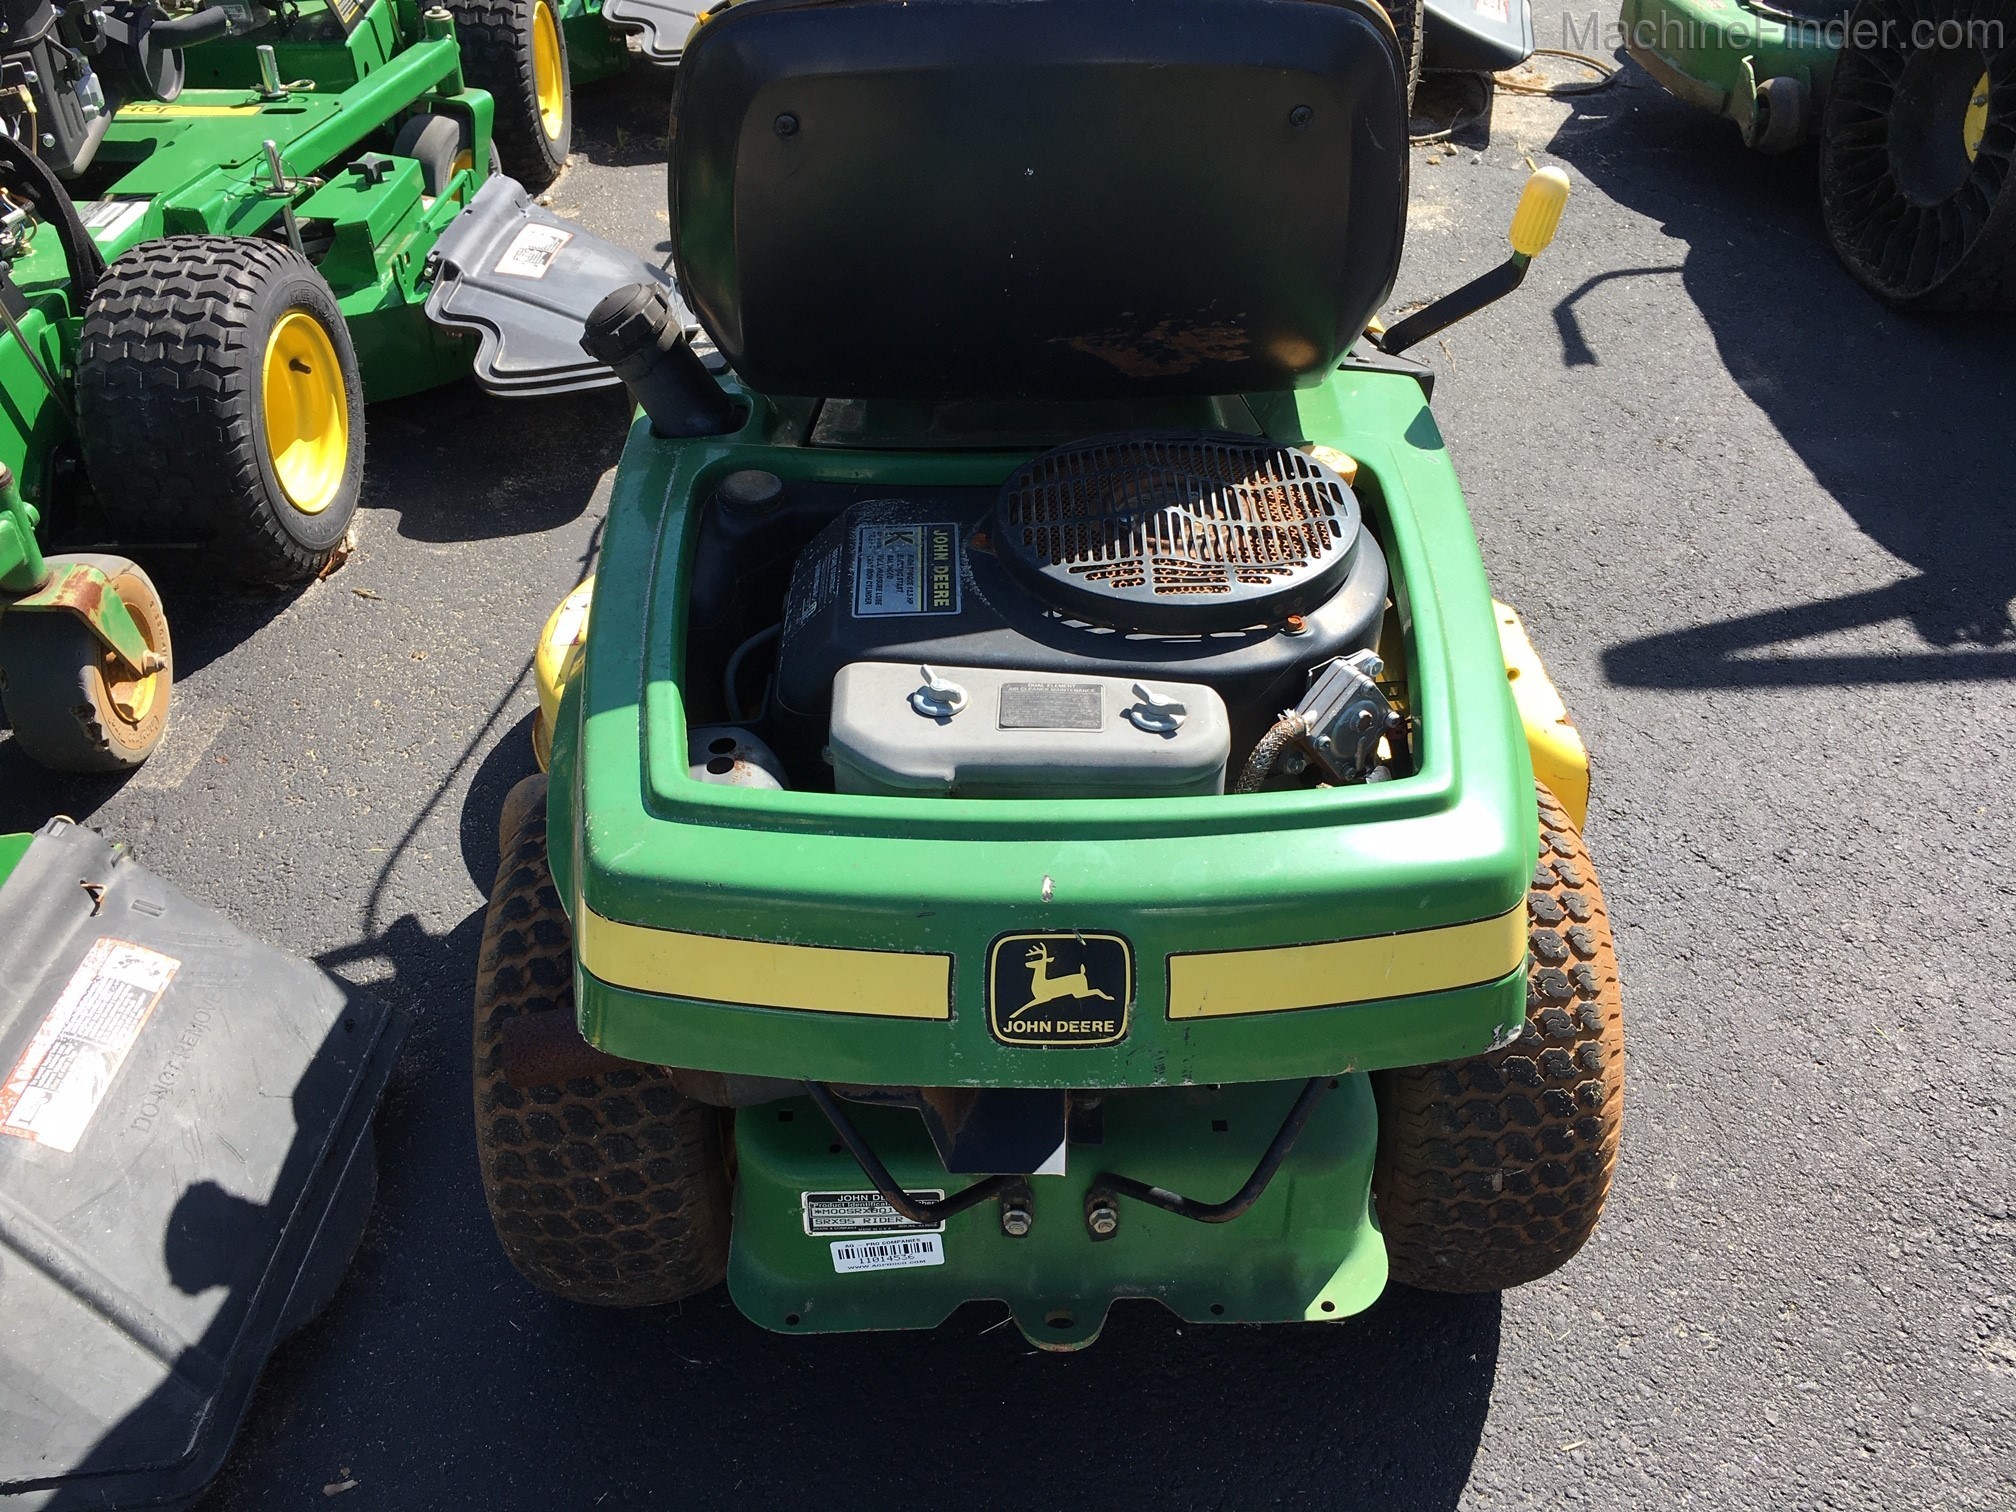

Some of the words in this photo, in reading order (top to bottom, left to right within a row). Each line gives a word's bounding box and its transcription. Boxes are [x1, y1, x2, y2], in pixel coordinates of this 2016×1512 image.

[933, 529, 949, 561] JOHN
[865, 581, 873, 605] CYLINDER
[933, 566, 950, 607] DEERE
[1003, 1020, 1051, 1033] JOHN
[1056, 1020, 1115, 1033] DEERE
[130, 1102, 160, 1133] DO
[837, 1194, 868, 1202] JOHN
[859, 1253, 915, 1265] 11014536
